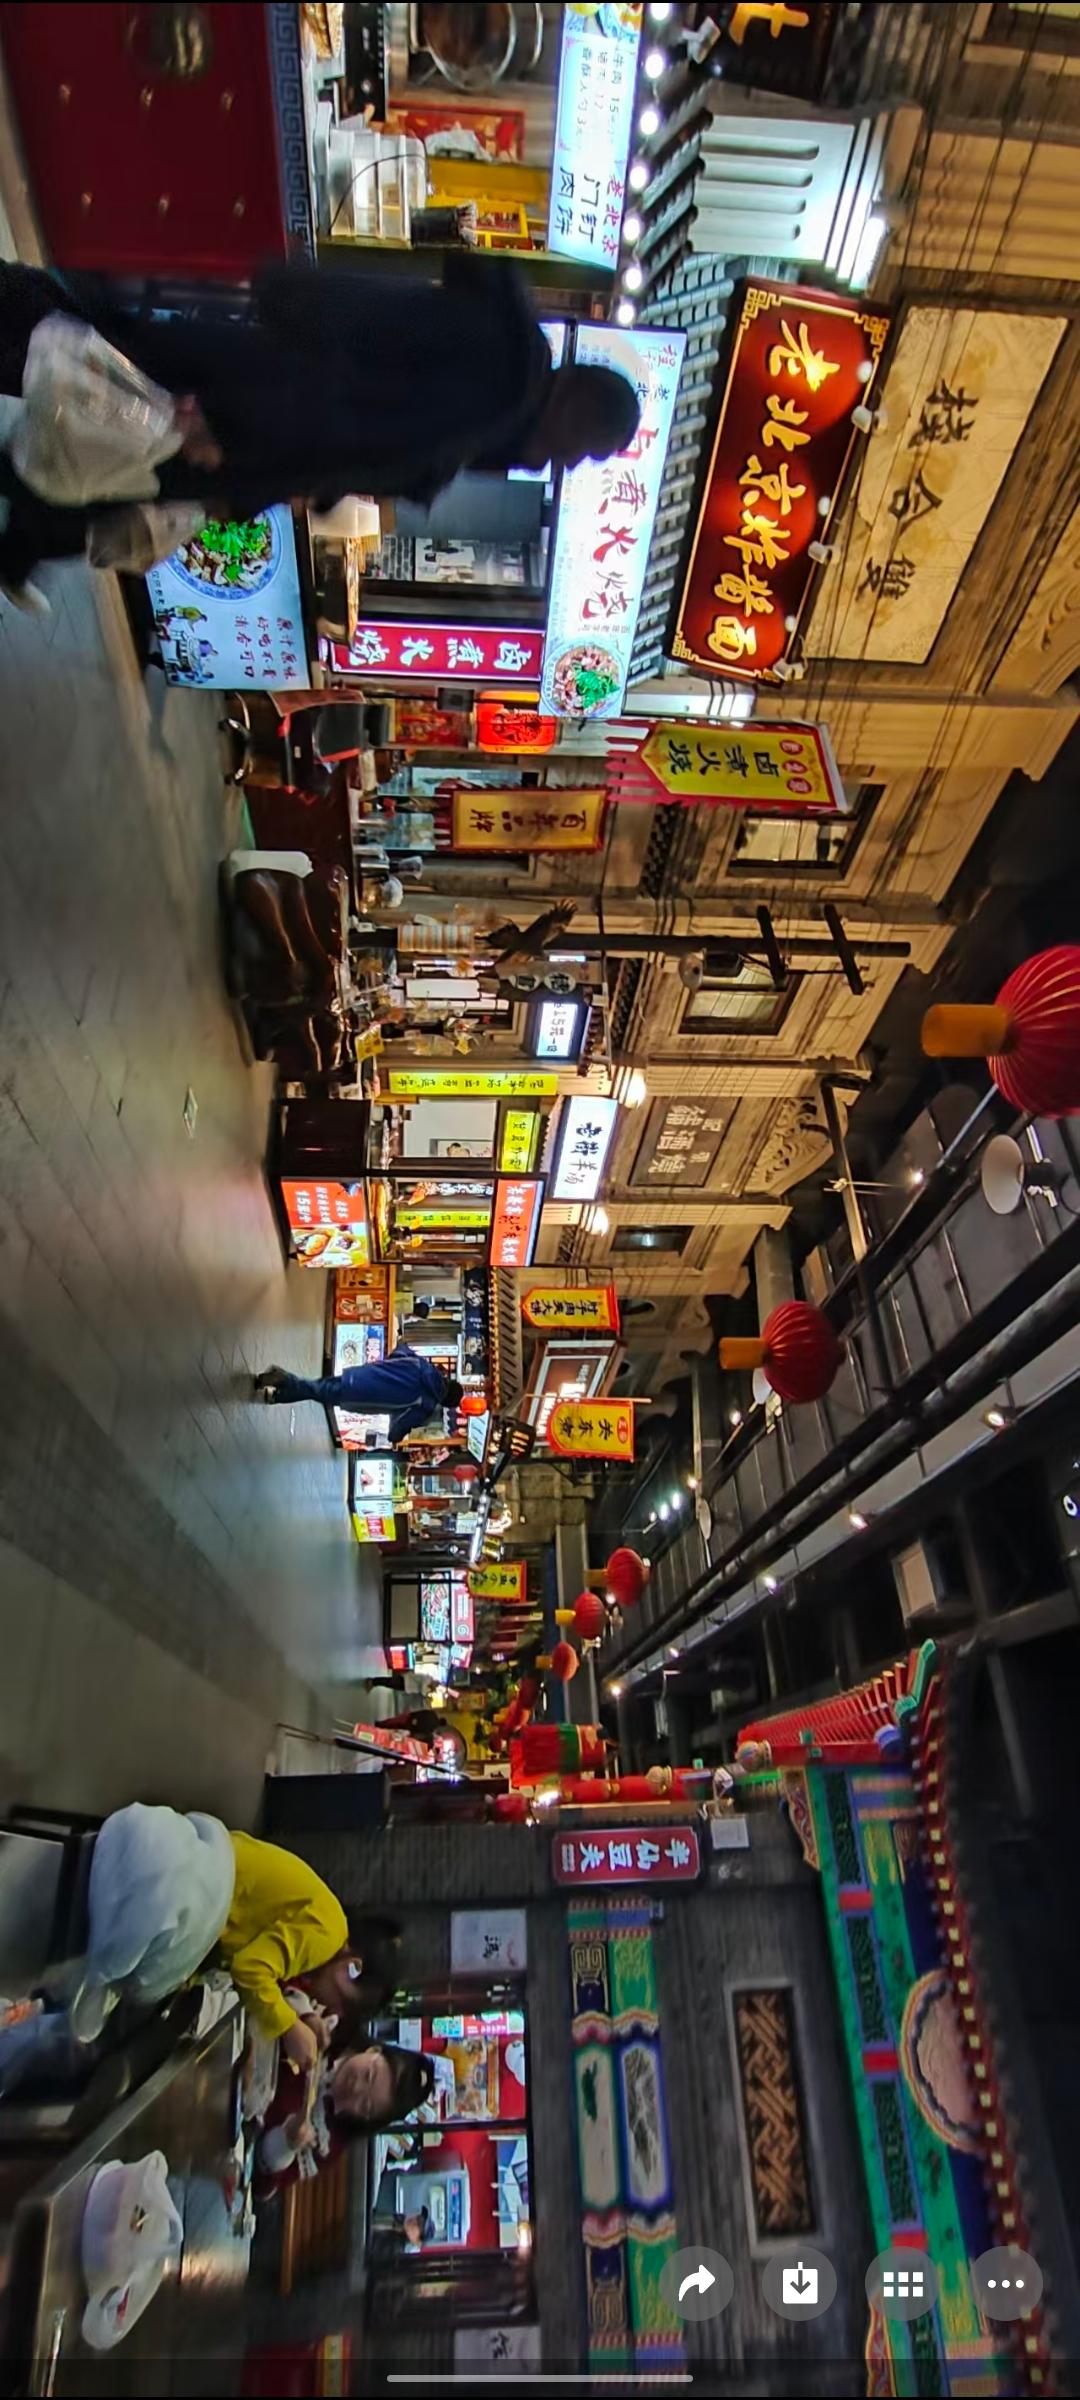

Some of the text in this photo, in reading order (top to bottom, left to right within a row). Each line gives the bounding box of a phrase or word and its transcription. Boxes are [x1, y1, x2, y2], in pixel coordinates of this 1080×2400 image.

[554, 167, 575, 236] 肉饼
[579, 174, 600, 244] 门钉
[602, 175, 624, 257] 老北京
[277, 617, 297, 680] 原汁原味
[349, 631, 531, 671] 卤煮火烧
[668, 739, 779, 778] 卤煮火烧
[469, 809, 587, 833] 百年品牌
[564, 1122, 603, 1184] 老街羊汤
[559, 1416, 613, 1441] 关东煮
[579, 1838, 690, 1873] 半仙豆夫
